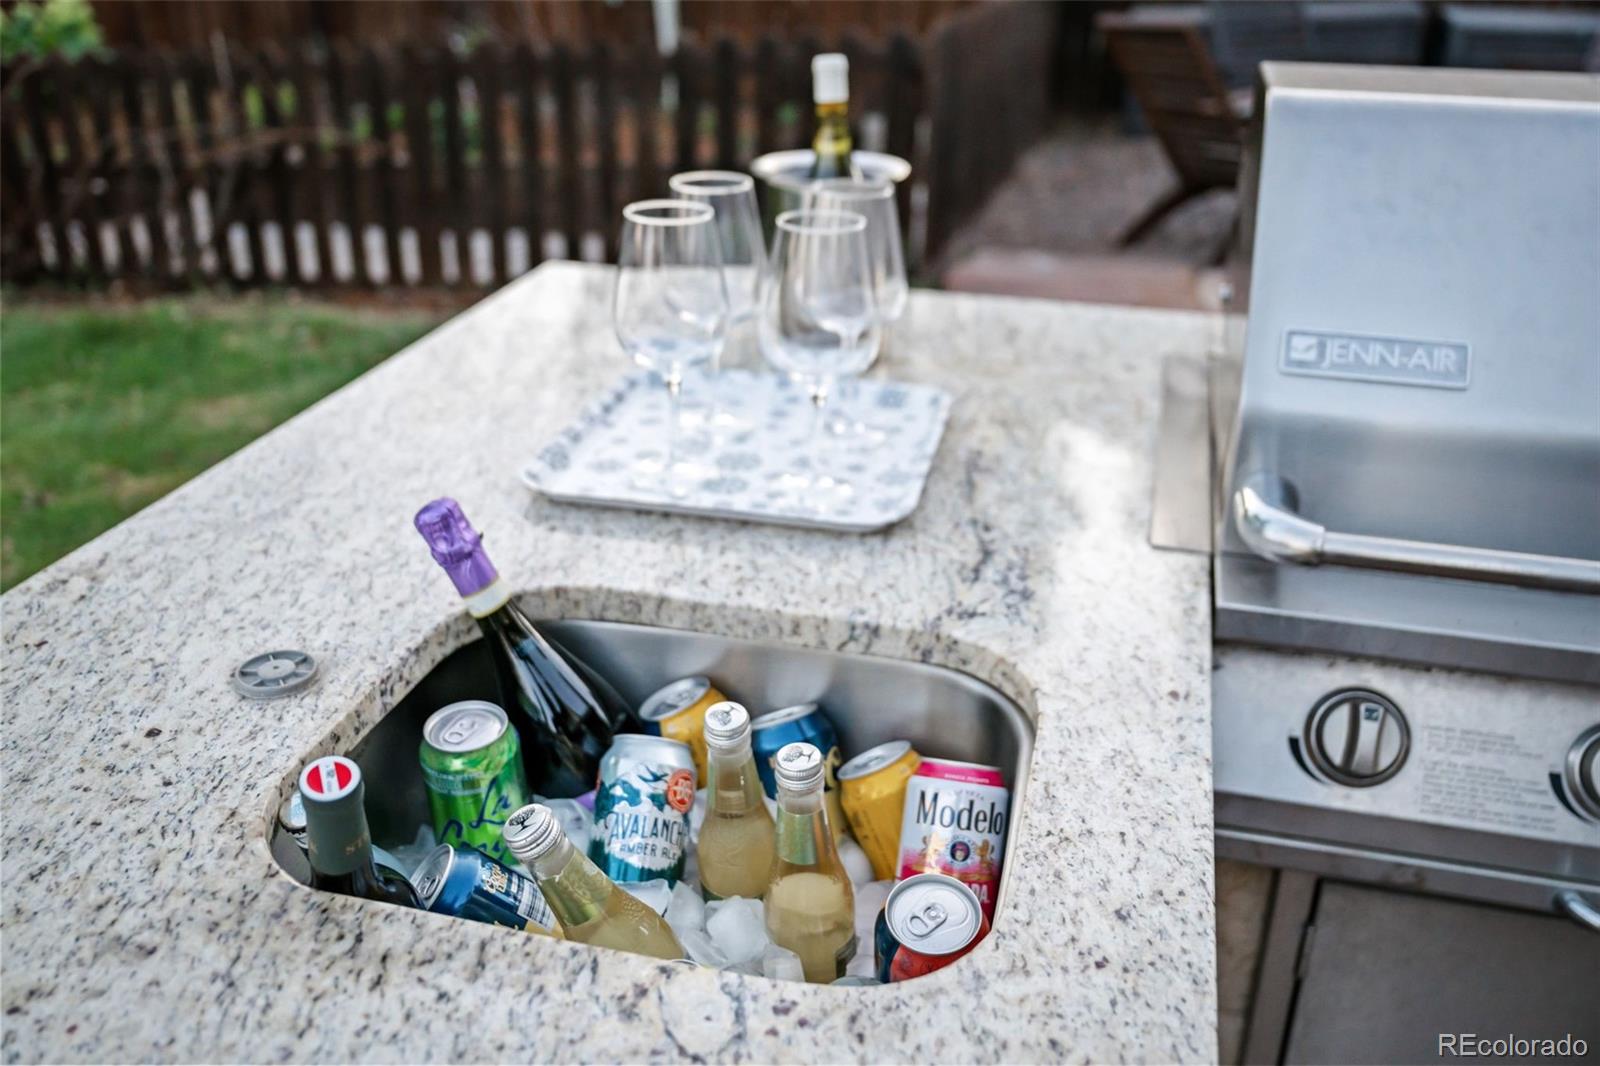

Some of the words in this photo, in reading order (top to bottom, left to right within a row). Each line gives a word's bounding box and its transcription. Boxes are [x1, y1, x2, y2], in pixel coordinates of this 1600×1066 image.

[1321, 339, 1457, 372] JENN-AIR
[469, 776, 511, 829] La
[916, 789, 1003, 835] Modelo
[620, 842, 658, 857] AMBER
[661, 847, 677, 861] ALE
